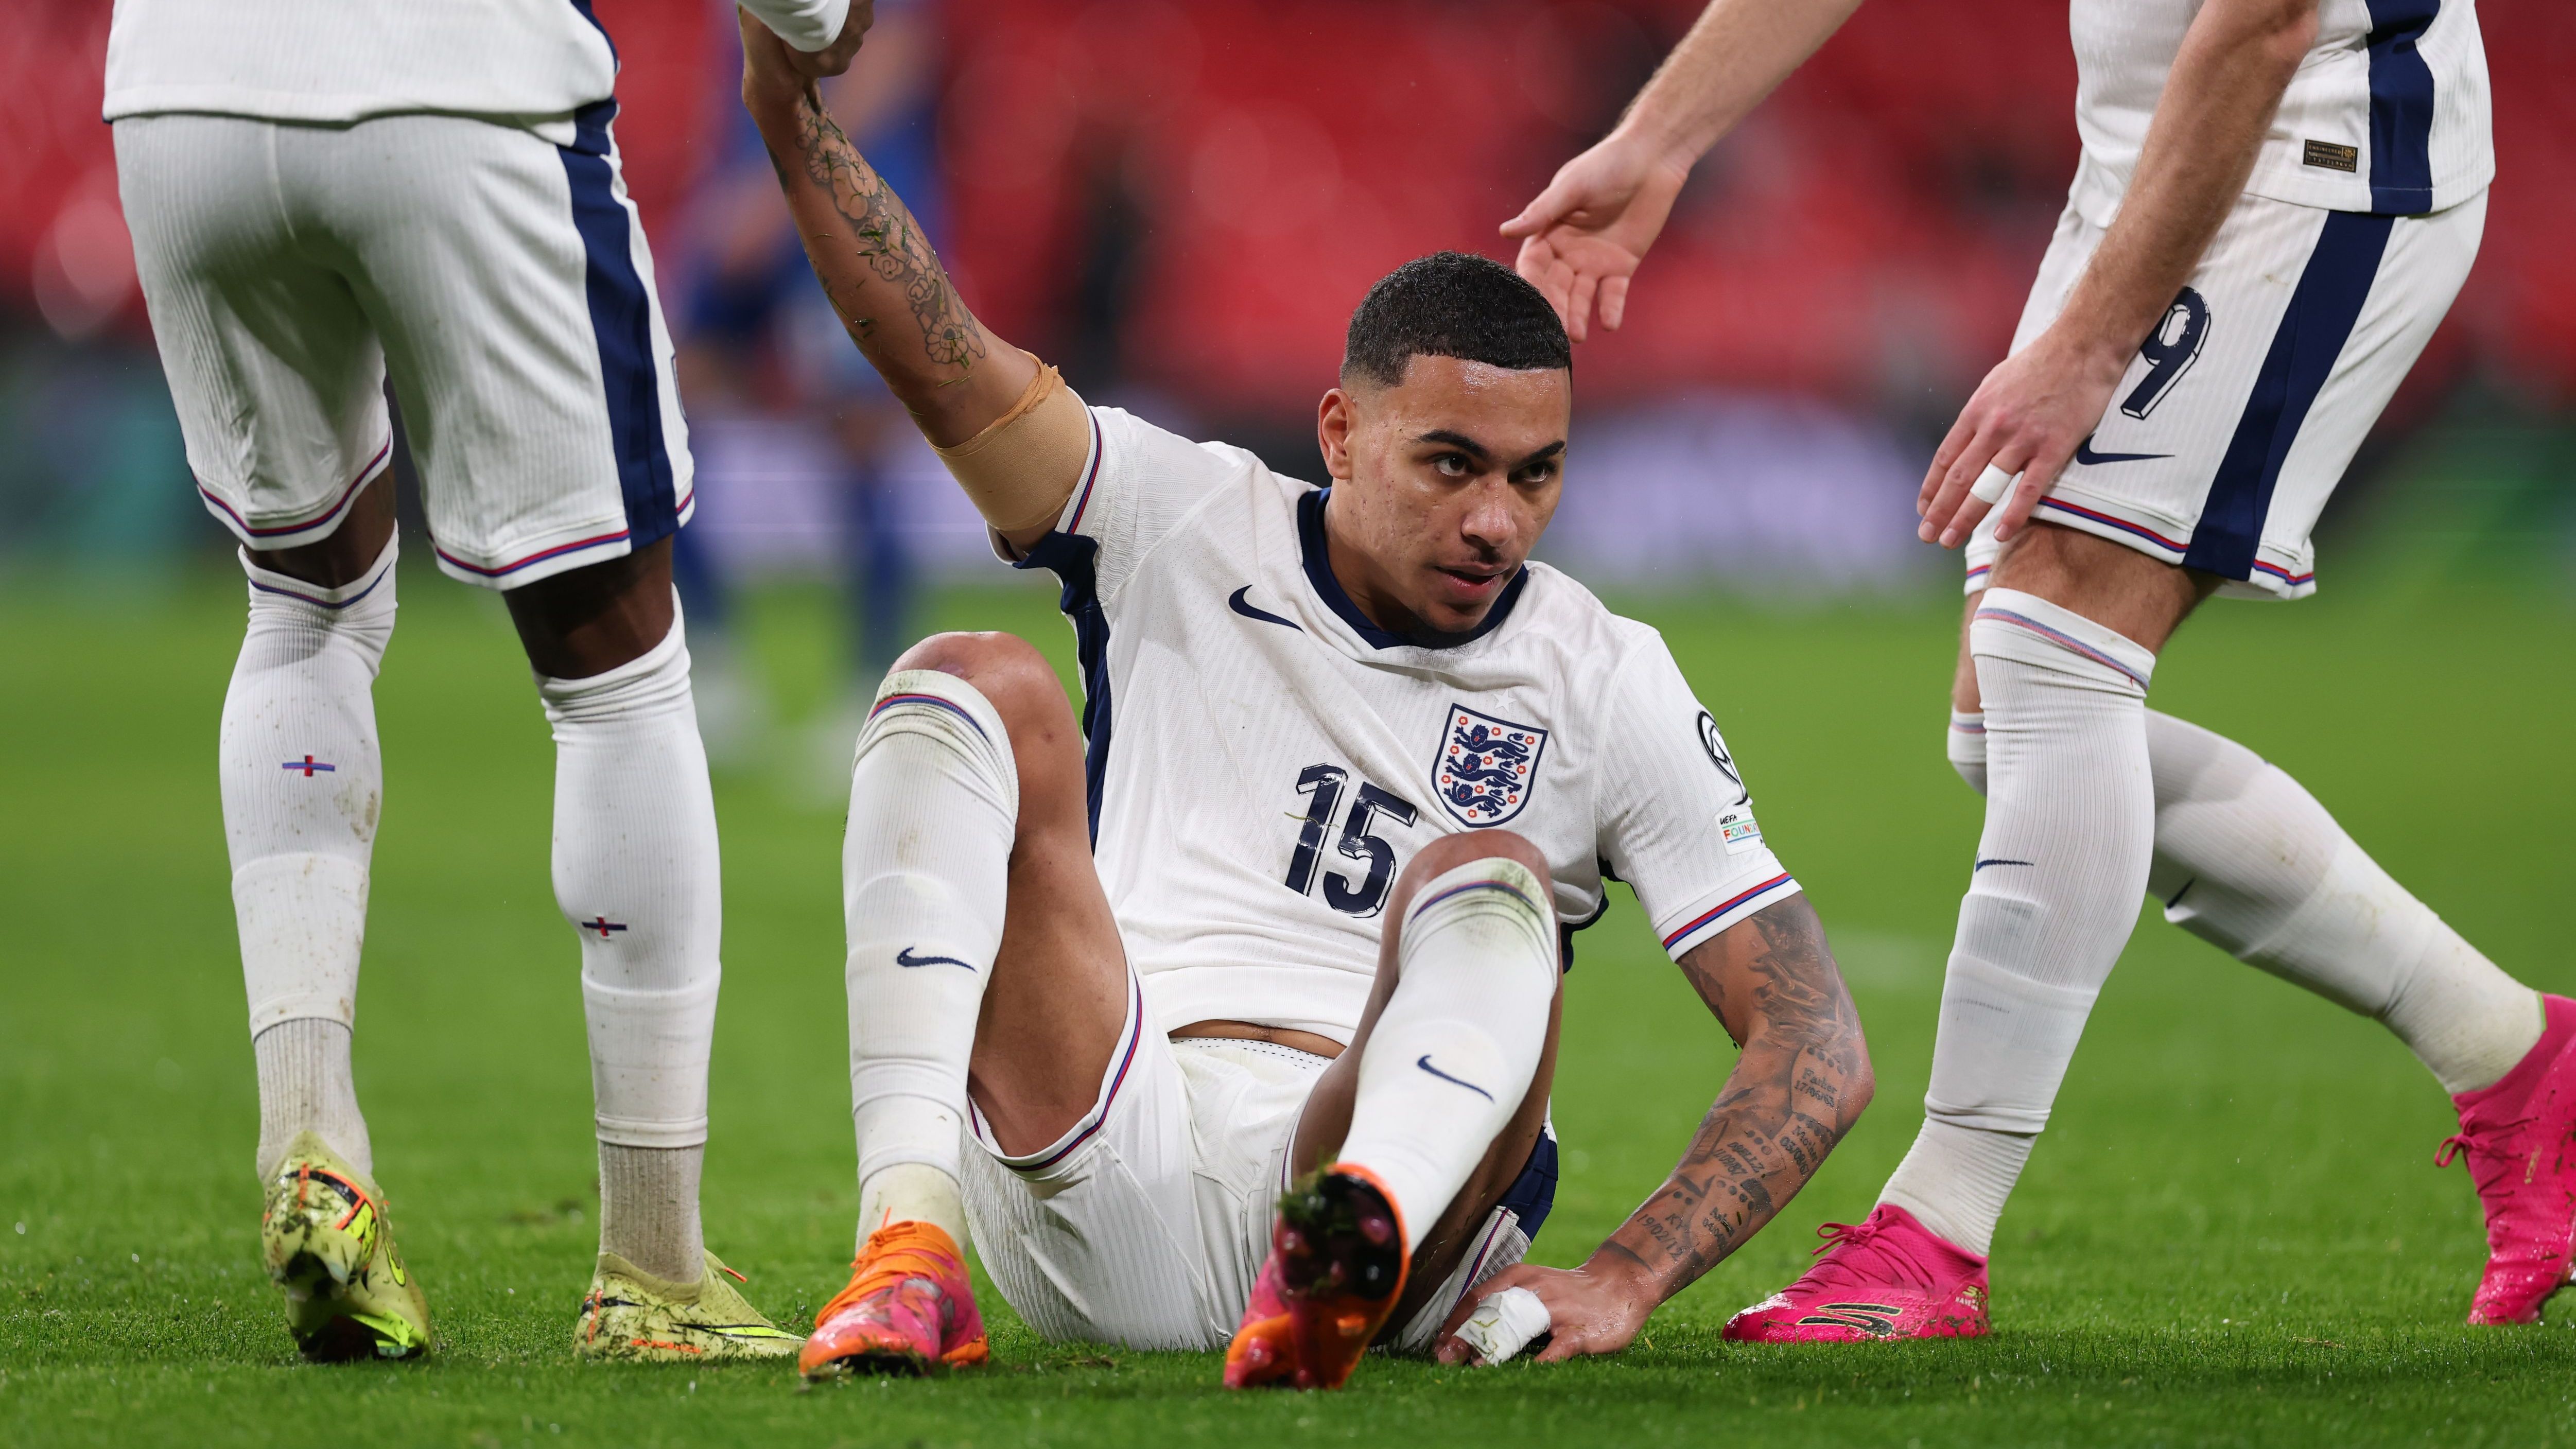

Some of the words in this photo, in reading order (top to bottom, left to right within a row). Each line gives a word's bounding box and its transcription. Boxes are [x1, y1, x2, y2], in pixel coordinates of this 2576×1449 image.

[2120, 286, 2212, 421] 9
[1285, 762, 1418, 918] 15
[1720, 814, 1737, 825] UEFA
